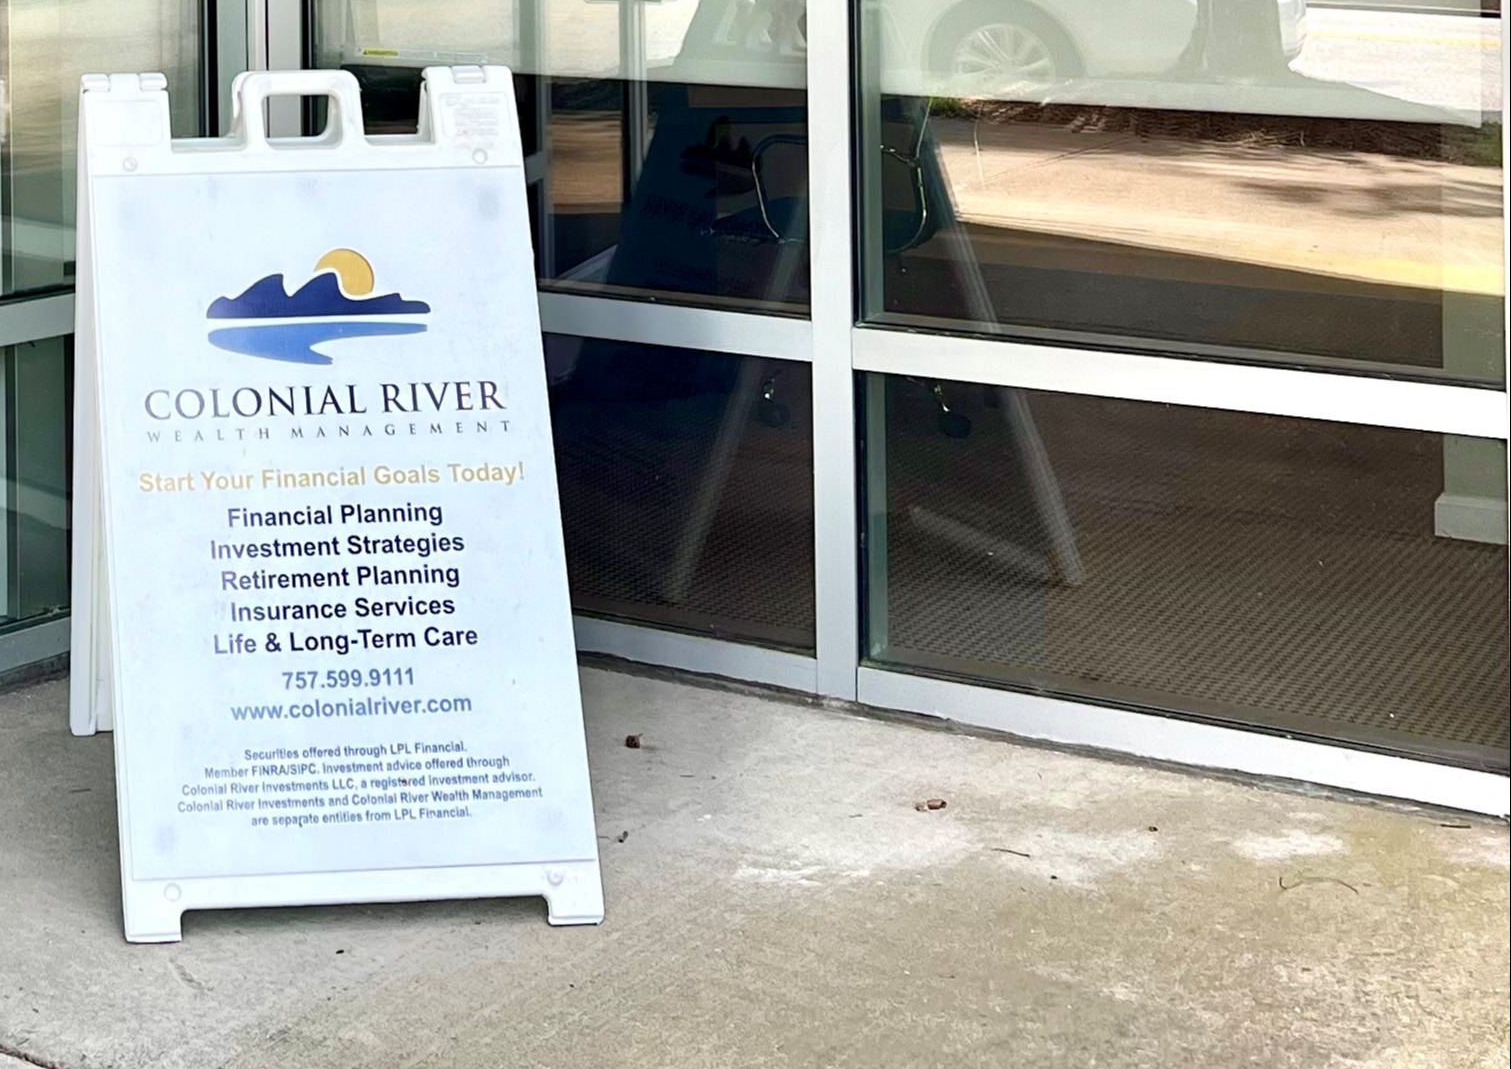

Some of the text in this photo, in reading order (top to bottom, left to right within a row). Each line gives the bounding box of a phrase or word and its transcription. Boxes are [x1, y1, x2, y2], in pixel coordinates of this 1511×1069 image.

[144, 380, 506, 419] COLONIAL RIVER
[147, 420, 510, 442] WEALTH MANAGEMENT
[138, 460, 525, 493] Start Your Financial Goals Today!
[227, 501, 443, 527] Financial Planning
[211, 532, 465, 559] Investment Strategies
[221, 563, 460, 590] Retirement Planning
[231, 595, 455, 621] Insurance Services
[214, 625, 478, 655] Life & Long-Term Care
[281, 666, 413, 690] 757.599.9111
[230, 696, 472, 720] www.colonialriver.com
[244, 740, 467, 761] Securities offered through LPL Financial.
[204, 756, 510, 779] Member FINRA/SIPC. Investment advice offered through
[181, 771, 535, 796] Colonial River Investments LLC, a registered investment advisor.
[177, 786, 543, 813] Colonial River Investments and Colonial River Wealth Management
[251, 805, 472, 828] are separate entities from LPL Financial.
